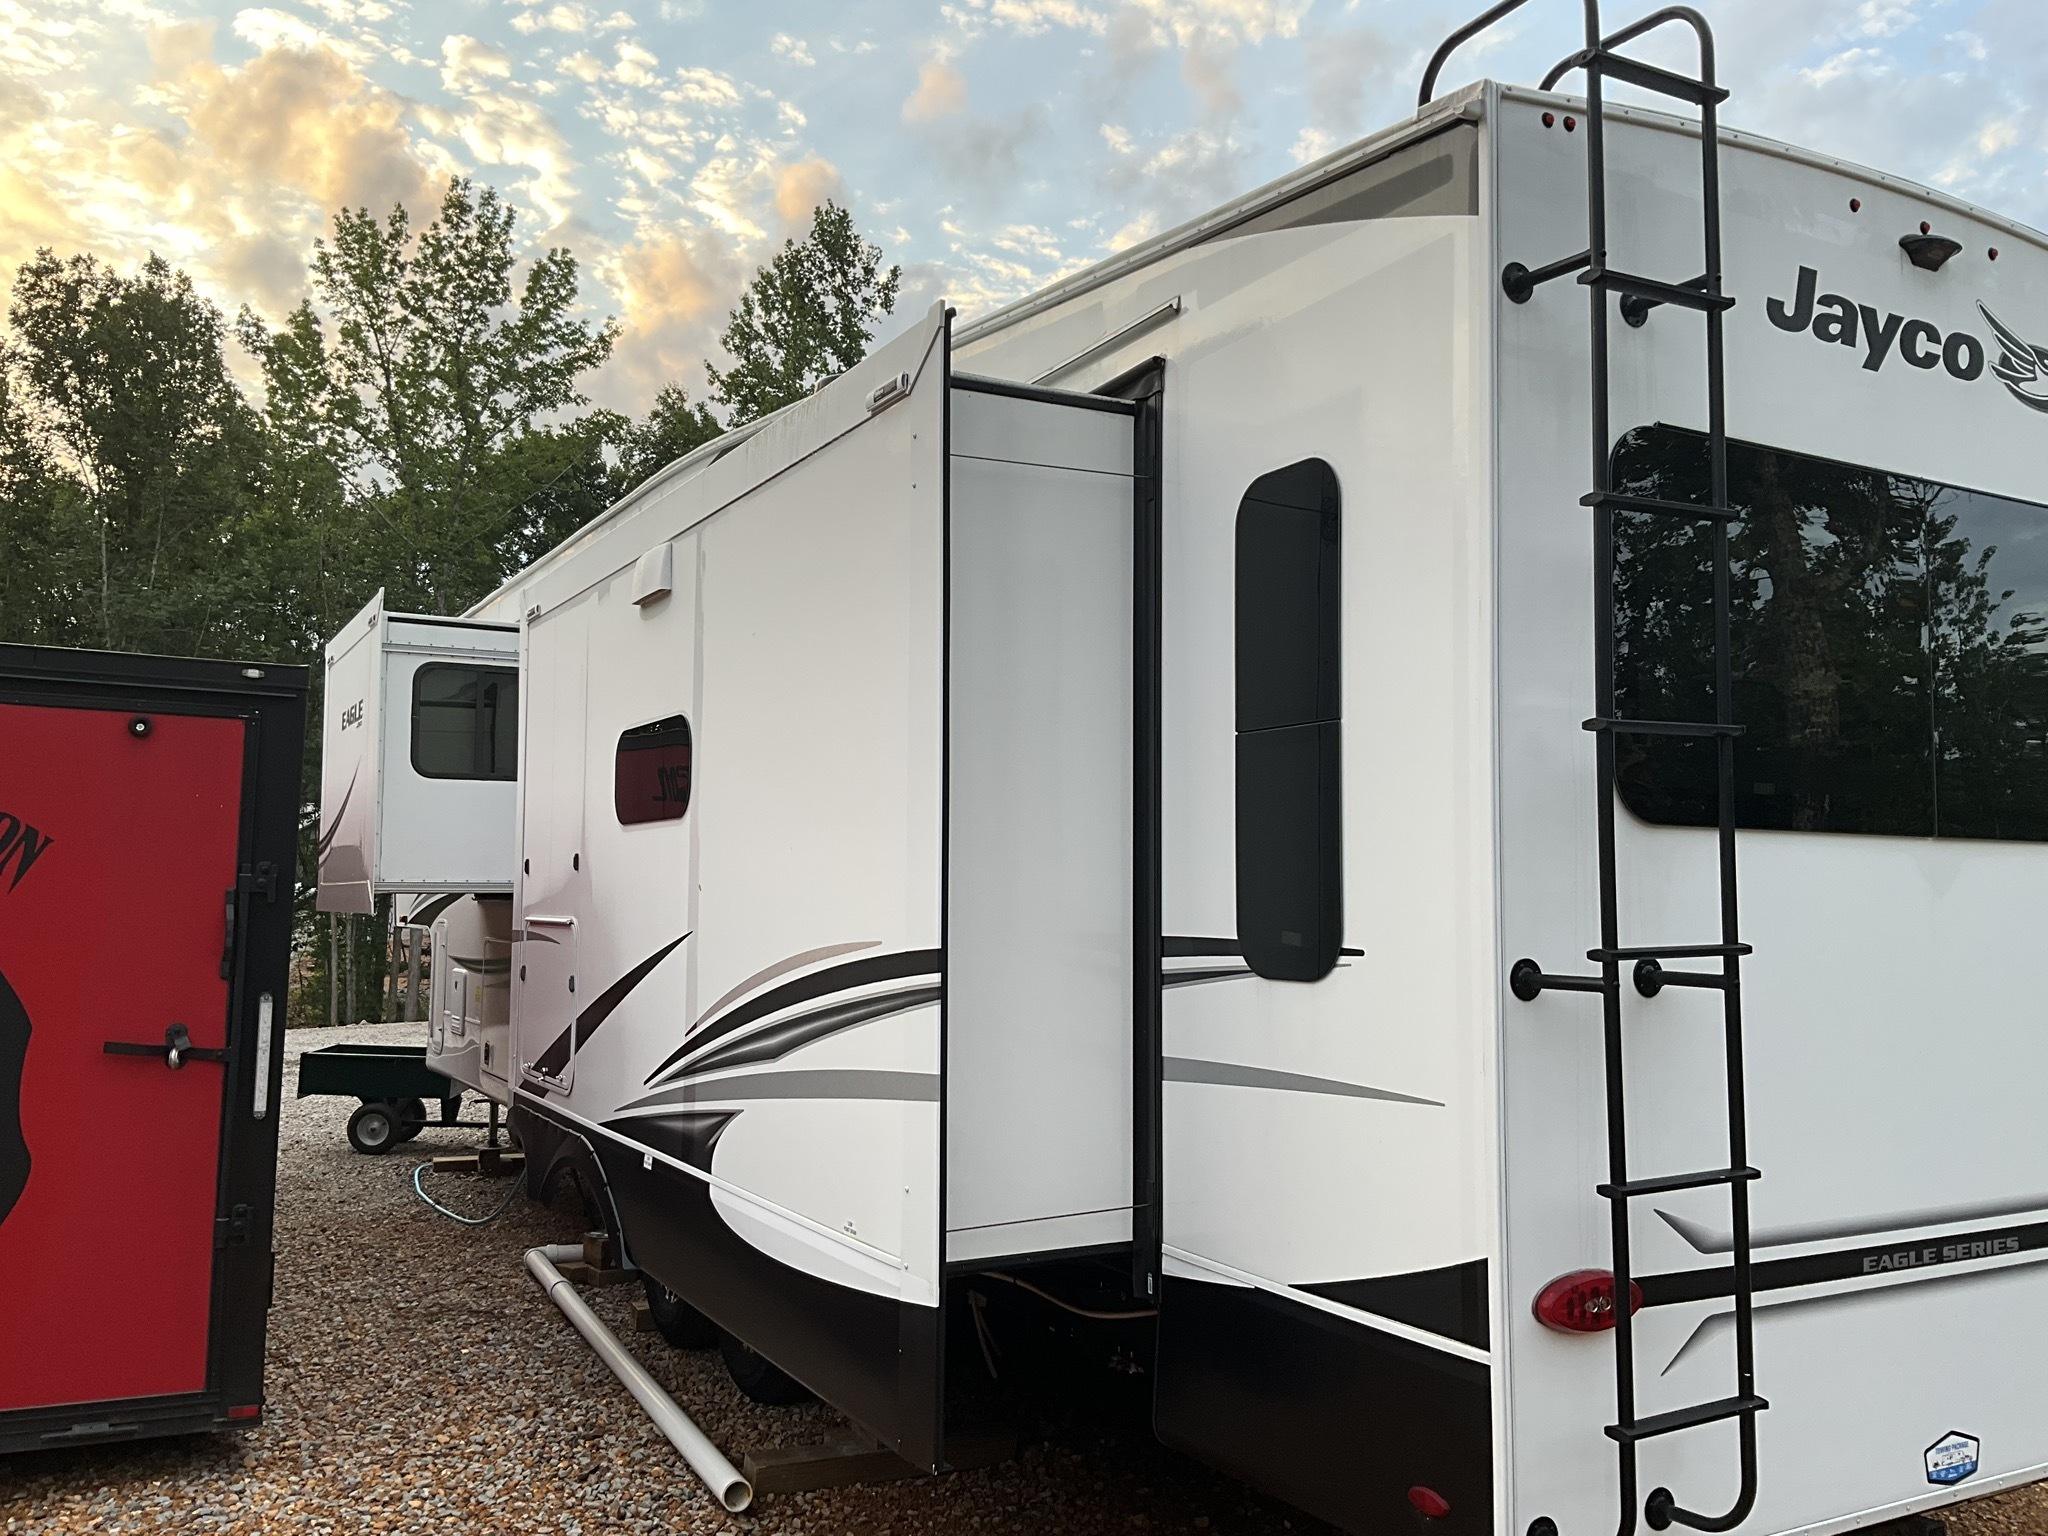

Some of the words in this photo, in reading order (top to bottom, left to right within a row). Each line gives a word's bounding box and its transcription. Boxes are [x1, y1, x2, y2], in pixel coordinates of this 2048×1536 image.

[1766, 265, 1984, 381] Jayco
[342, 699, 363, 731] EAGLE
[1863, 1248, 1937, 1273] EAGLE
[1943, 1237, 2019, 1261] SERIES
